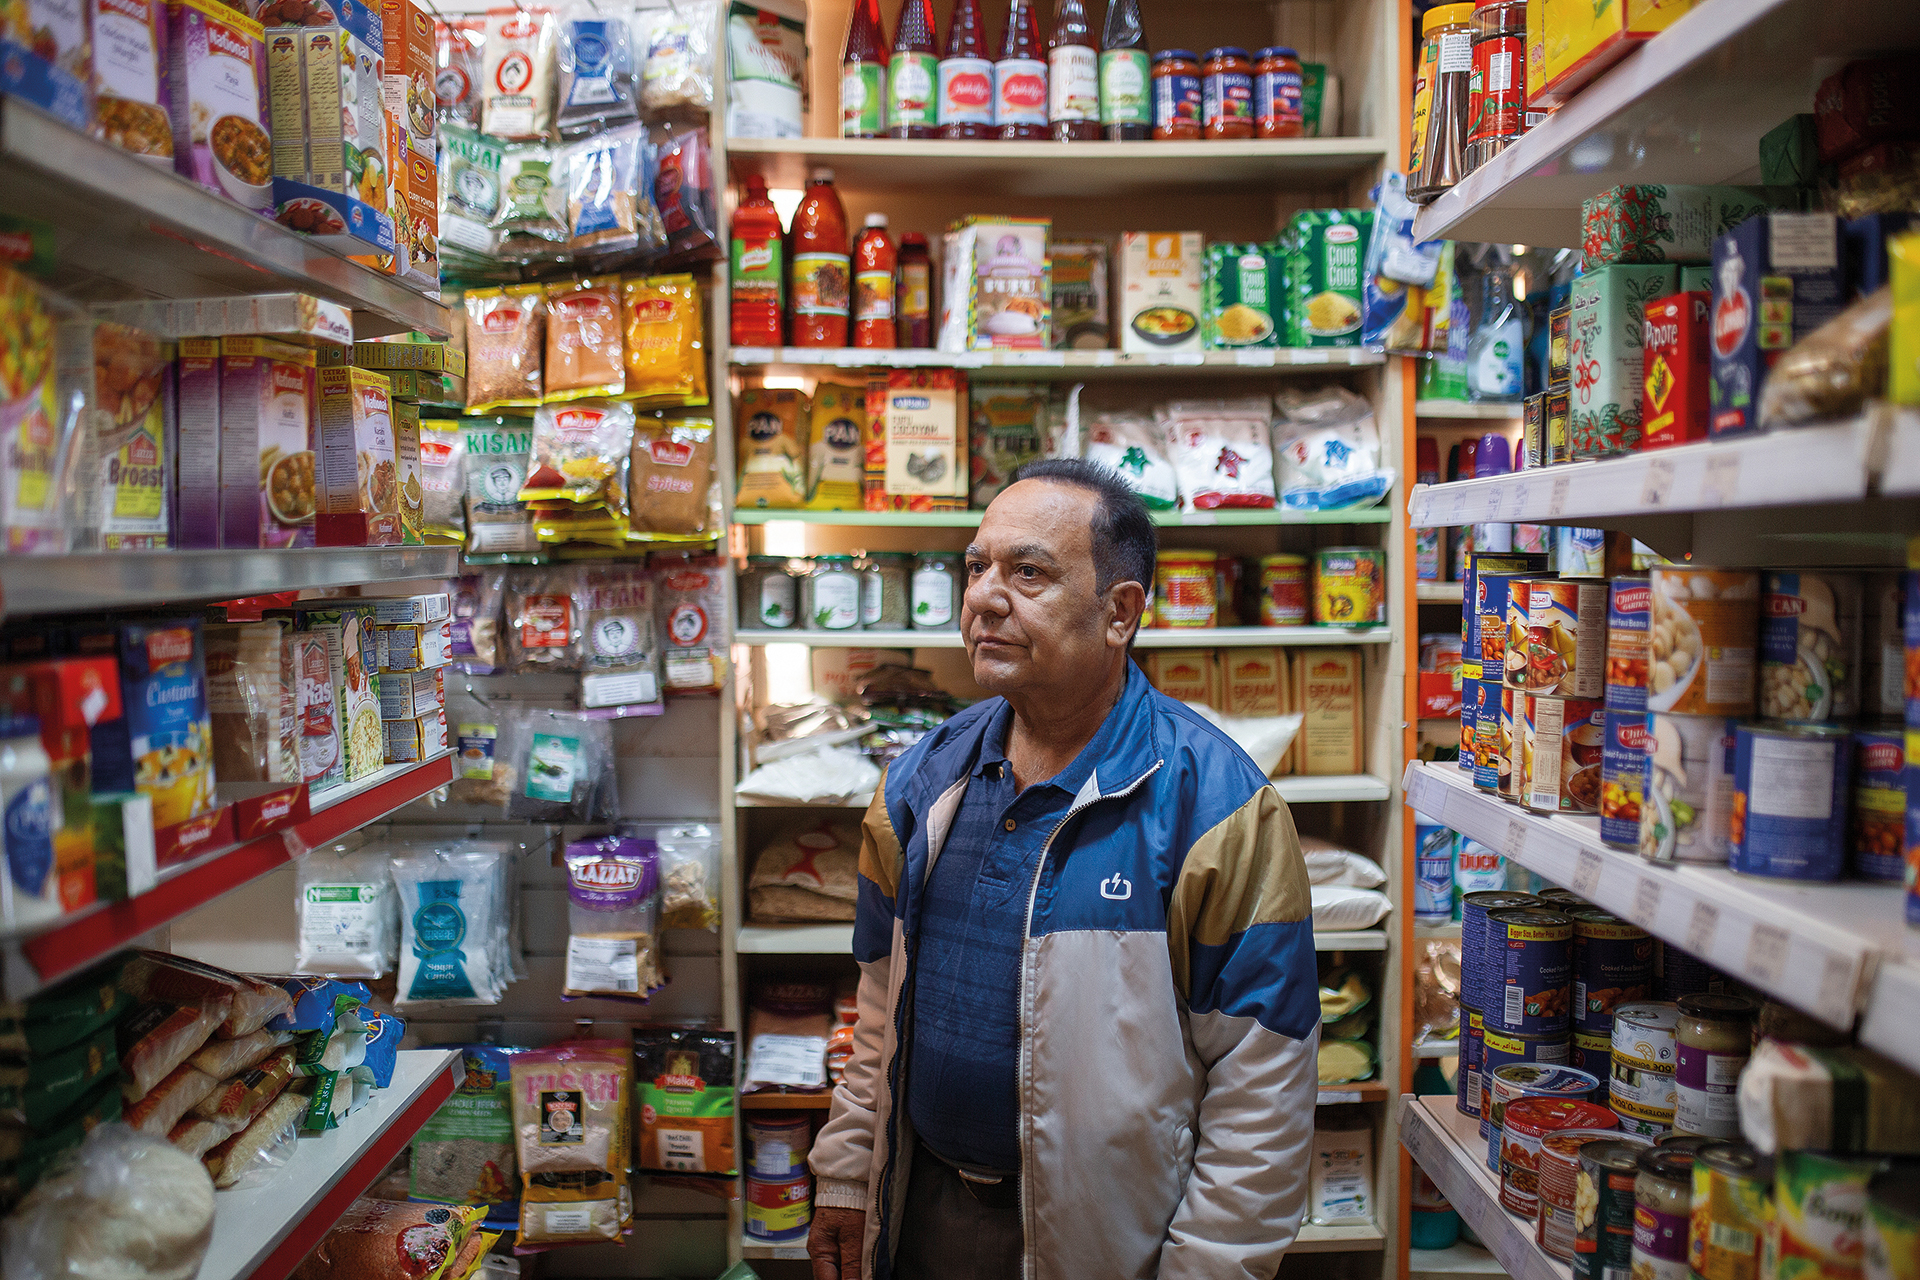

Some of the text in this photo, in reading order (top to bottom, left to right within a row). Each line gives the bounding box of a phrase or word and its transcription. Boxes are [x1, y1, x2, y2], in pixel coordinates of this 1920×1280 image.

[208, 26, 251, 60] National
[1326, 244, 1358, 267] COUS
[1242, 271, 1266, 288] COUS
[1326, 266, 1358, 287] COUS
[1242, 288, 1266, 304] COUS
[328, 320, 350, 337] Kofta
[1645, 320, 1678, 350] Pipore
[324, 387, 347, 395] National
[365, 393, 387, 411] National
[750, 416, 783, 432] PAN
[466, 432, 532, 454] KISAN
[825, 426, 861, 444] PAN
[108, 457, 164, 487] Broast
[146, 678, 199, 708] Custard
[301, 677, 332, 706] Ras
[1459, 853, 1500, 871] DUCK
[577, 864, 638, 885] LAZZAT
[1510, 928, 1523, 939] Bigger
[1533, 930, 1546, 939] Better
[1593, 928, 1606, 937] Better
[1606, 928, 1617, 937] Price
[426, 962, 455, 974] Sugar
[1539, 966, 1557, 974] Cooked
[1600, 964, 1620, 972] Cooked
[525, 1074, 620, 1105] KISAN
[664, 1076, 696, 1086] Malka
